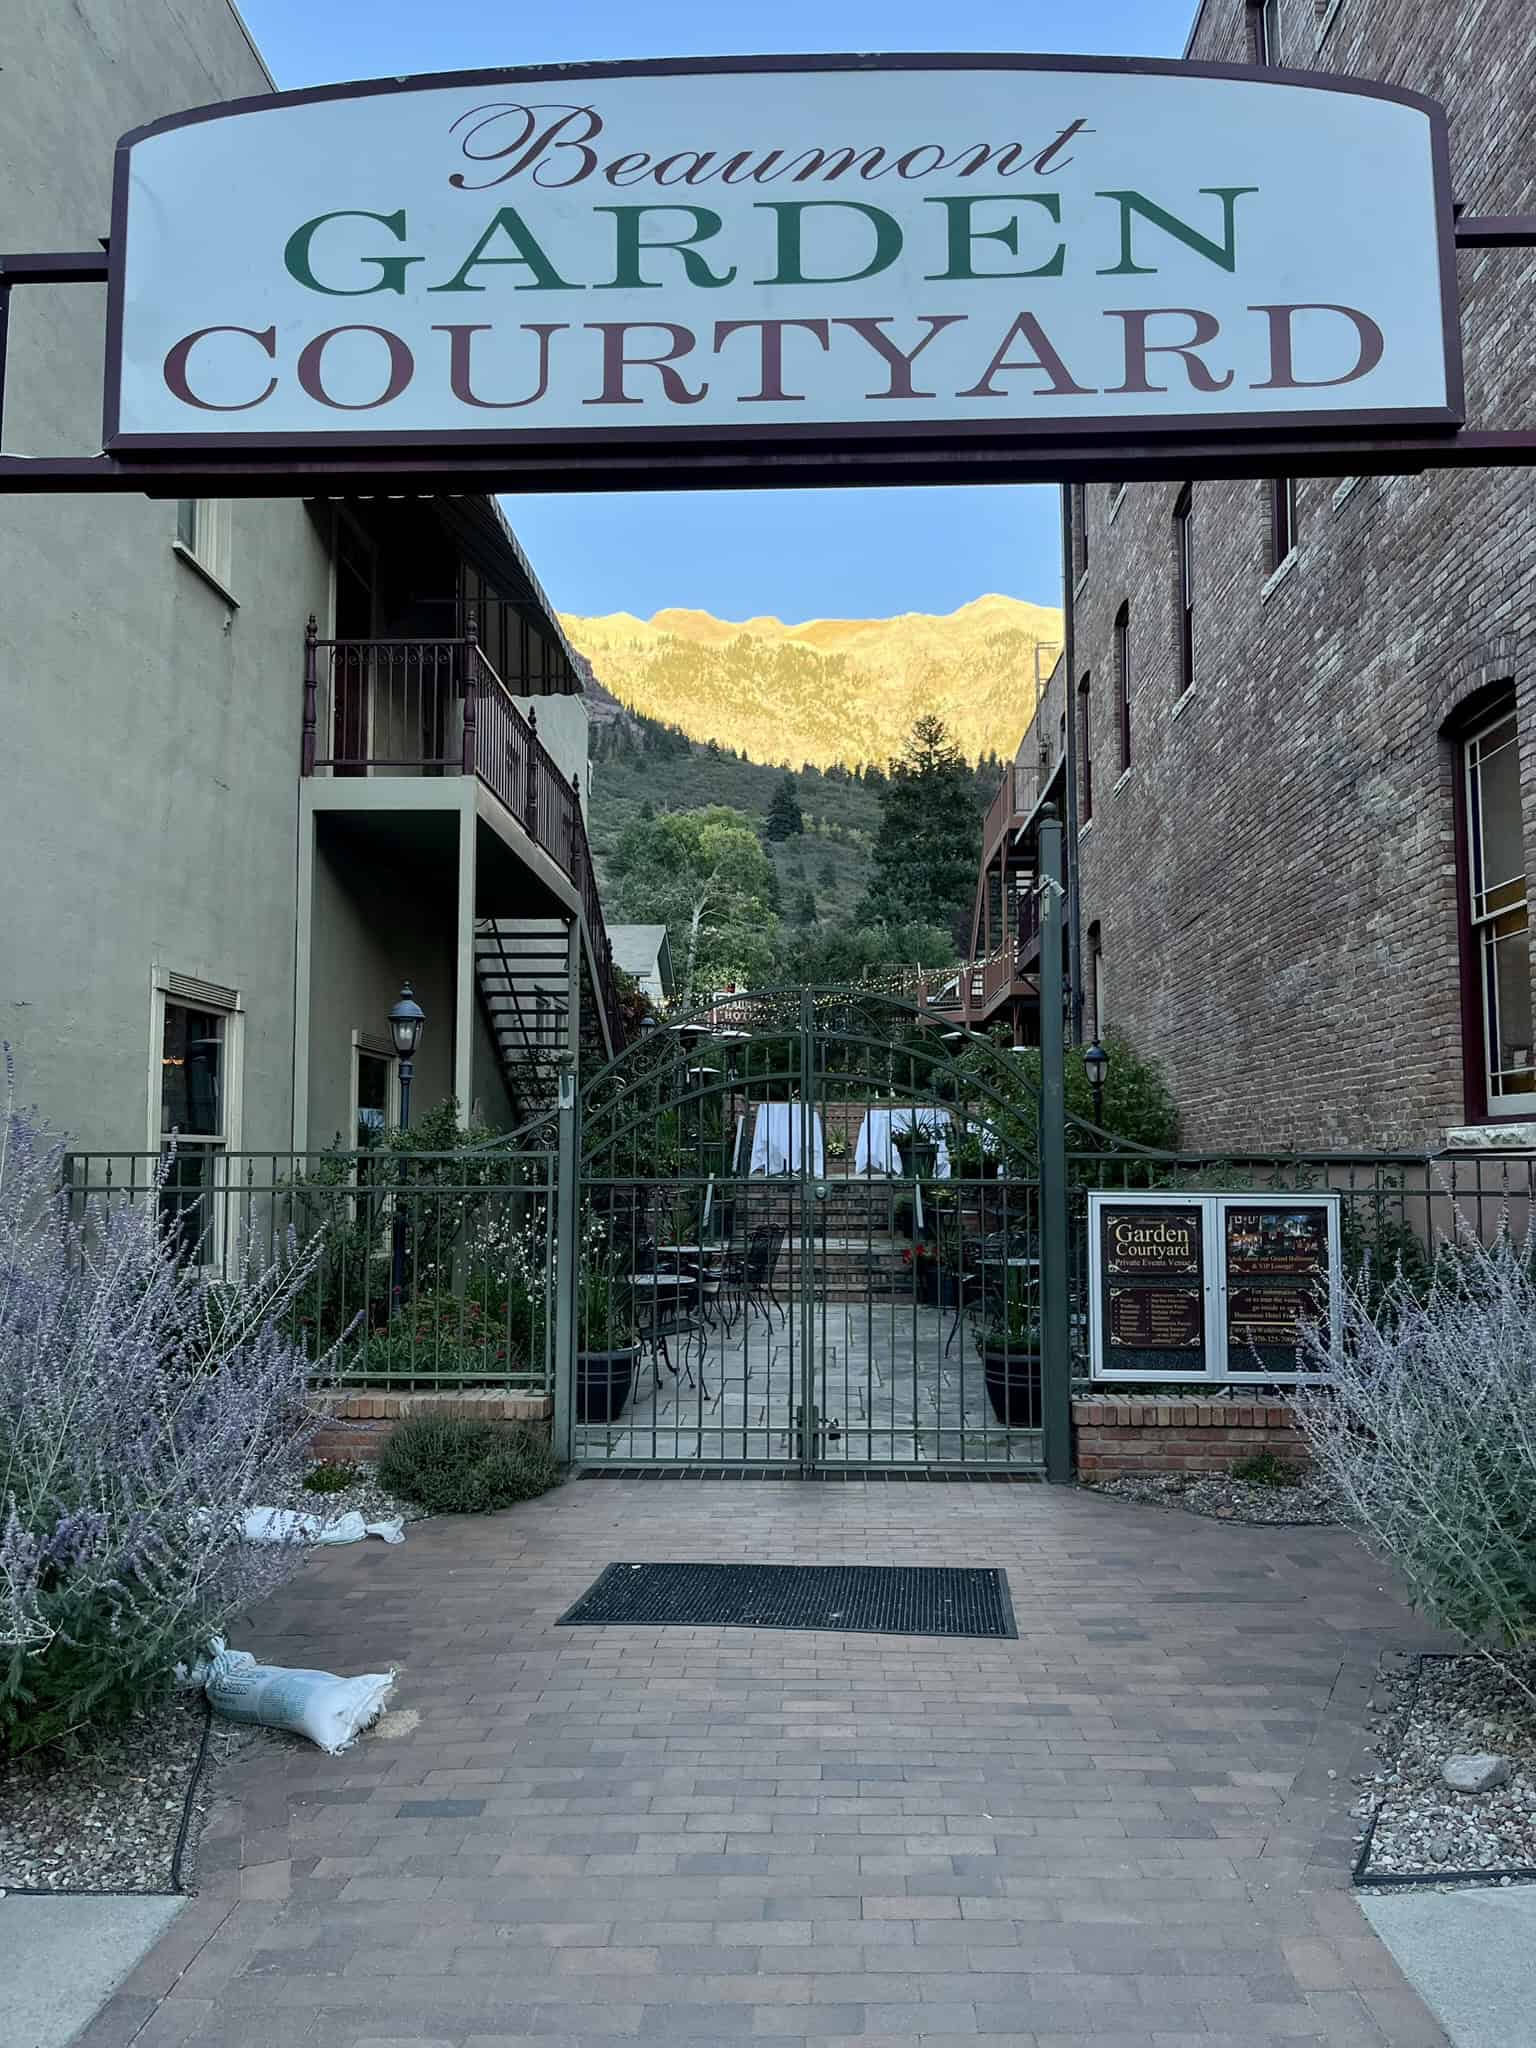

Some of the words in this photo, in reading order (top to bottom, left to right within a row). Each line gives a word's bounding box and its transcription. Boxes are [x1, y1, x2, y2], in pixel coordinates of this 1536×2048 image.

[449, 103, 1096, 190] Beaumont
[285, 188, 1259, 296] GARDEN
[164, 304, 1384, 411] COURTYARD
[1116, 1223, 1190, 1243] Garden
[1116, 1242, 1190, 1260] Courtyard
